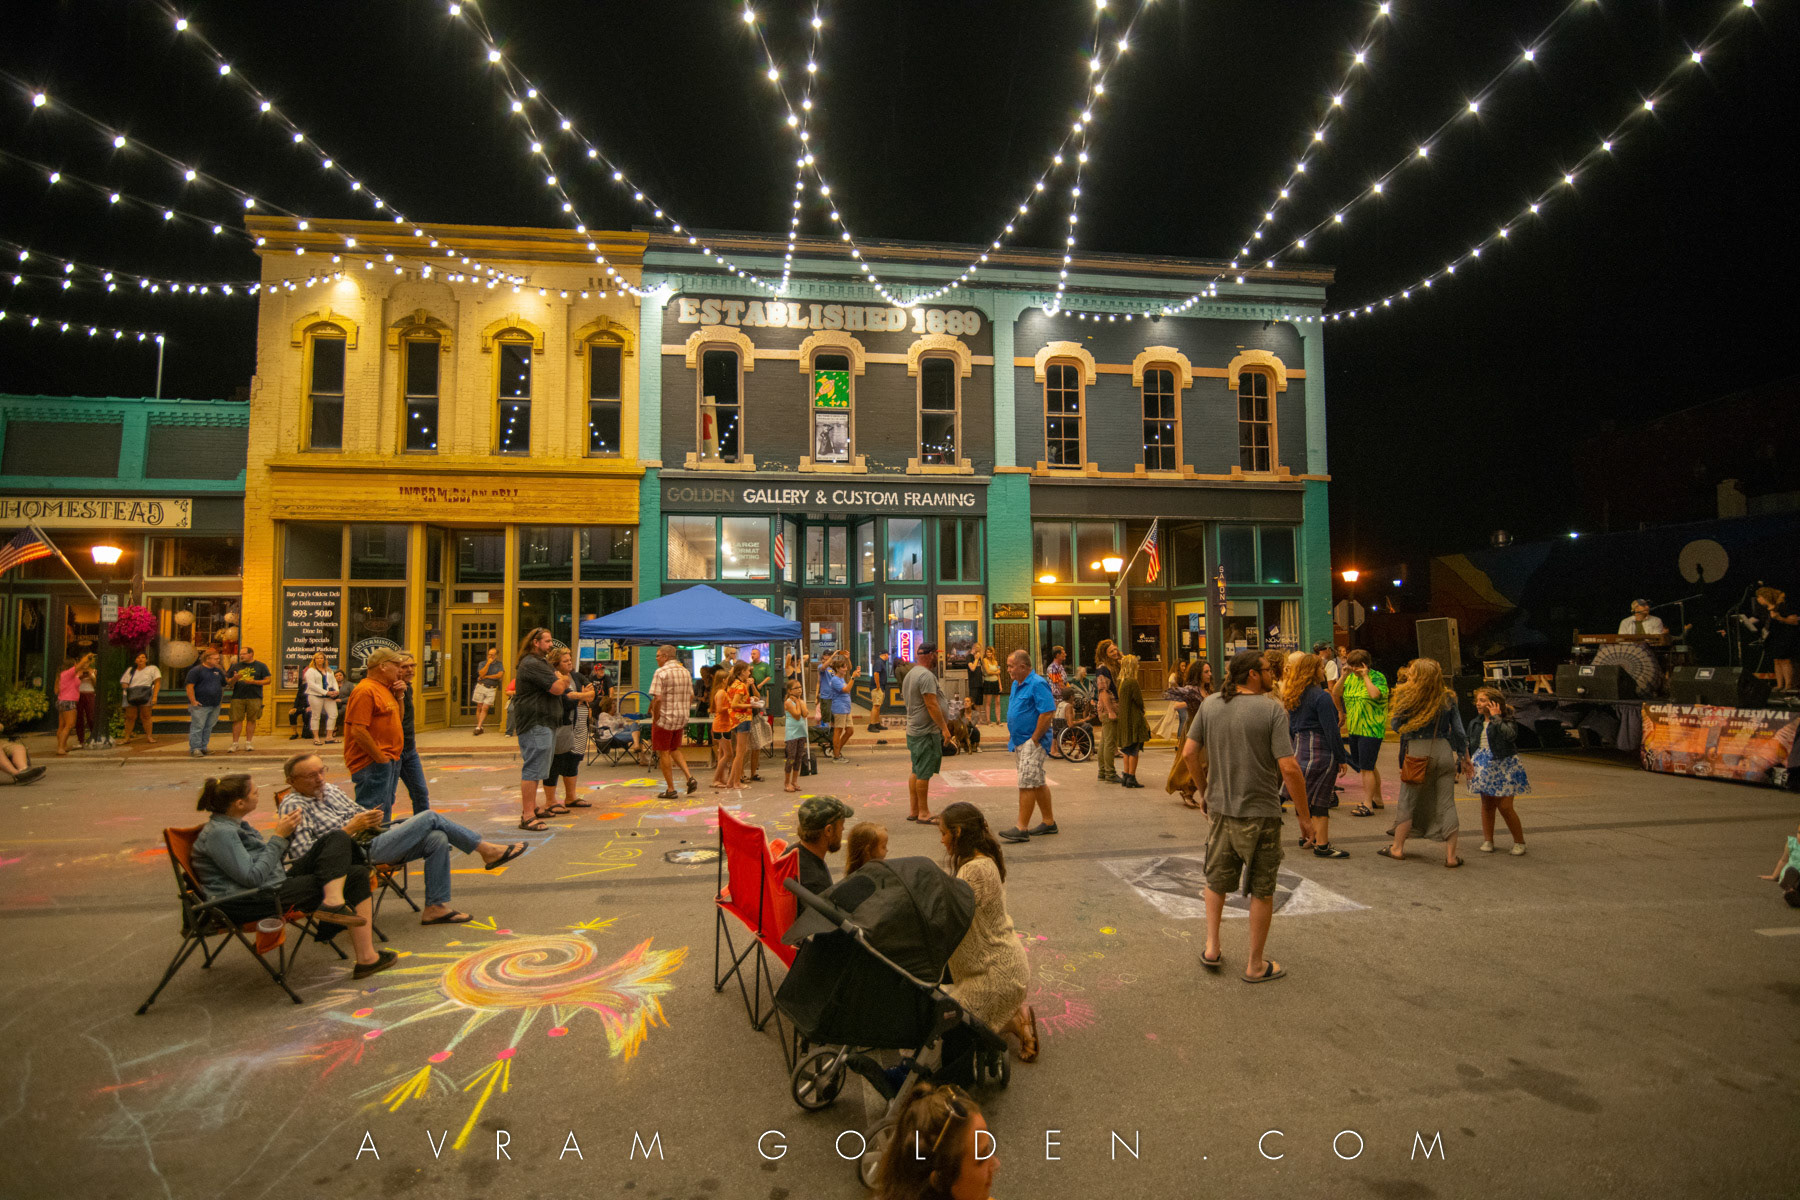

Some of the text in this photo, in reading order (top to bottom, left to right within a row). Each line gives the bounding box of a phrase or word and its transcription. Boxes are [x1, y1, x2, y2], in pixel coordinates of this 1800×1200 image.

[678, 298, 980, 336] ESTABLISHED 1889
[666, 487, 976, 506] GOLDEN GALLERY & CUSTOM FRAMING
[0, 500, 164, 526] HOMESTEAD
[354, 640, 399, 651] INTERMISSION
[901, 632, 910, 662] OPEN
[1649, 704, 1790, 720] CHALK WALK ART FESTIVAL
